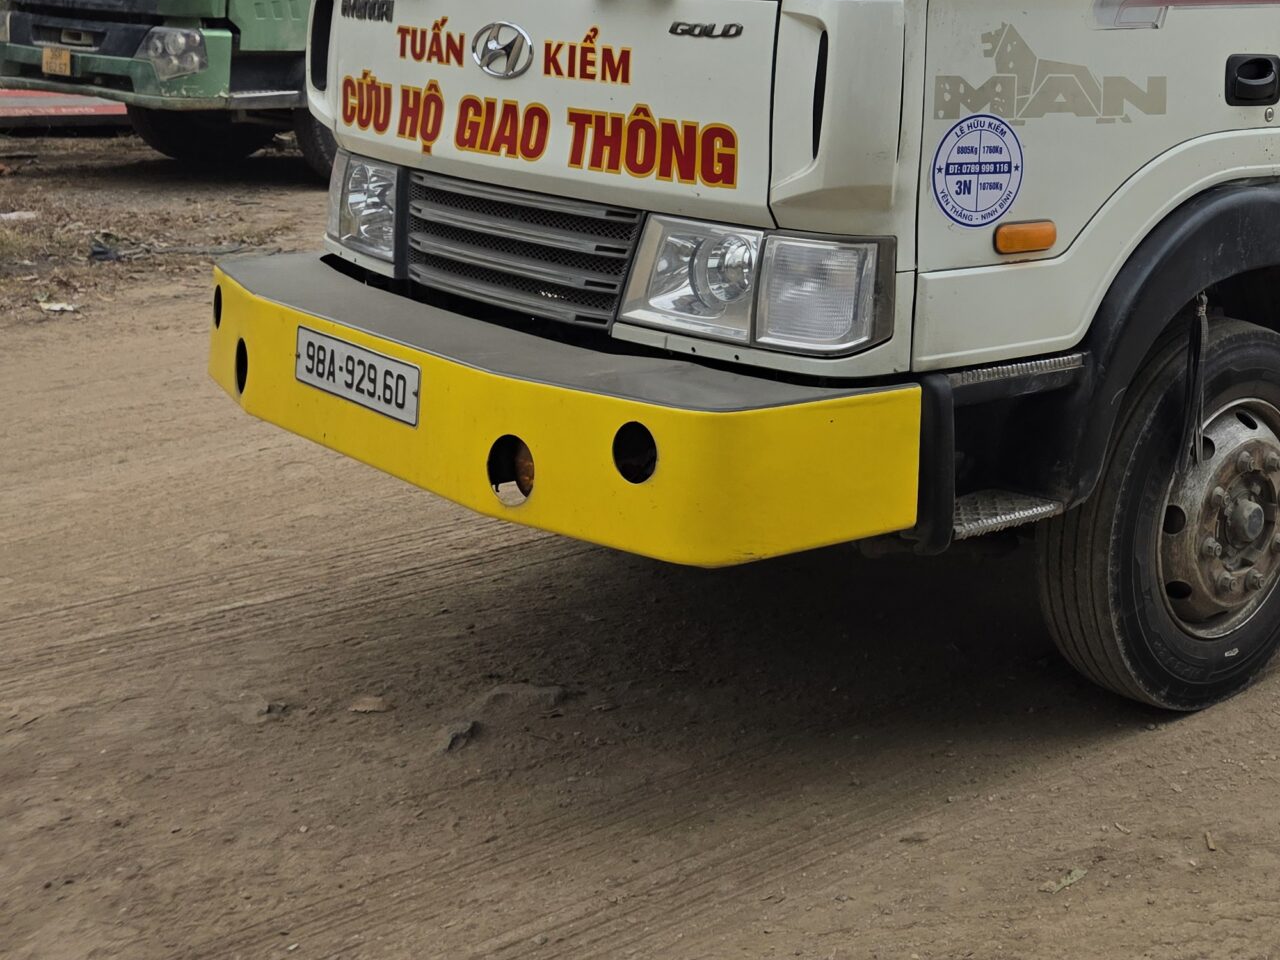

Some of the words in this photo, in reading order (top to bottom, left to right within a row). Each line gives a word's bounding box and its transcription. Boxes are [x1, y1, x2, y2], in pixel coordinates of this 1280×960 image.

[669, 21, 744, 38] GOLD
[397, 16, 466, 68] TUẤN
[543, 26, 632, 85] KIỂM
[933, 74, 1168, 122] MAN
[341, 69, 393, 136] CỨU
[397, 79, 446, 155] HỘ
[454, 94, 551, 162] GIAO
[567, 102, 739, 190] THÔNG
[966, 119, 986, 132] HỮU
[948, 164, 961, 174] ĐT:
[981, 163, 994, 173] 999
[955, 179, 972, 196] 3N
[939, 189, 951, 207] YÊN
[980, 208, 999, 222] NINH
[305, 340, 407, 410] 98A-929.60
